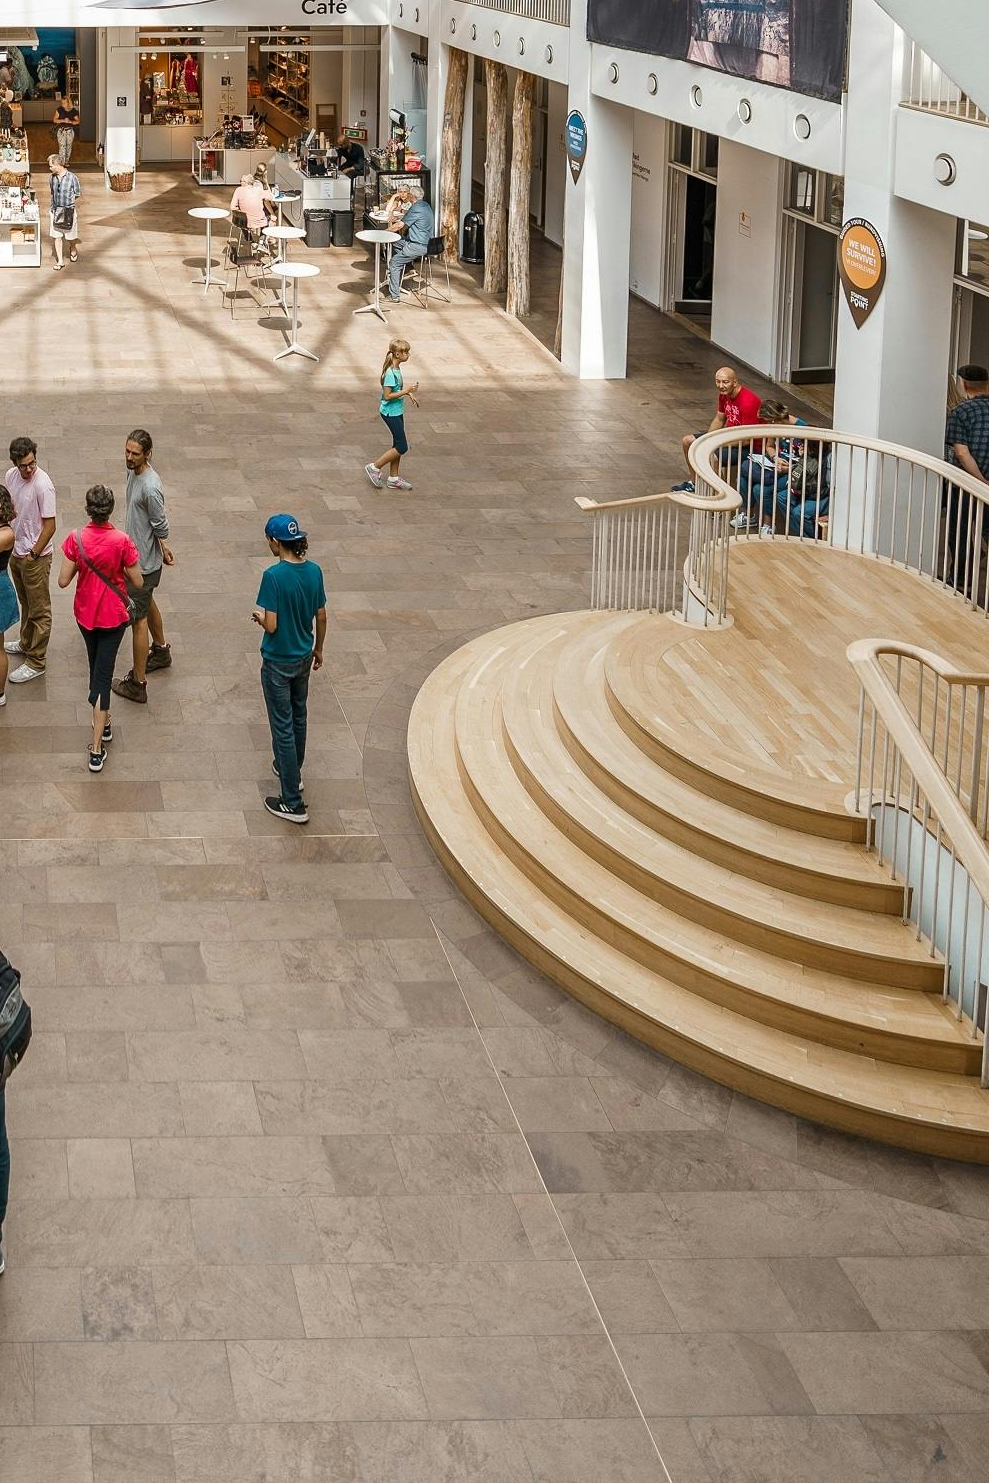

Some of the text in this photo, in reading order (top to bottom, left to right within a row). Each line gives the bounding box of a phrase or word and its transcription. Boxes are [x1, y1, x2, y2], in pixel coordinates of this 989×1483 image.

[846, 247, 876, 267] SURVIVE!
[848, 239, 876, 257] WE WILL
[850, 296, 869, 310] POINT
